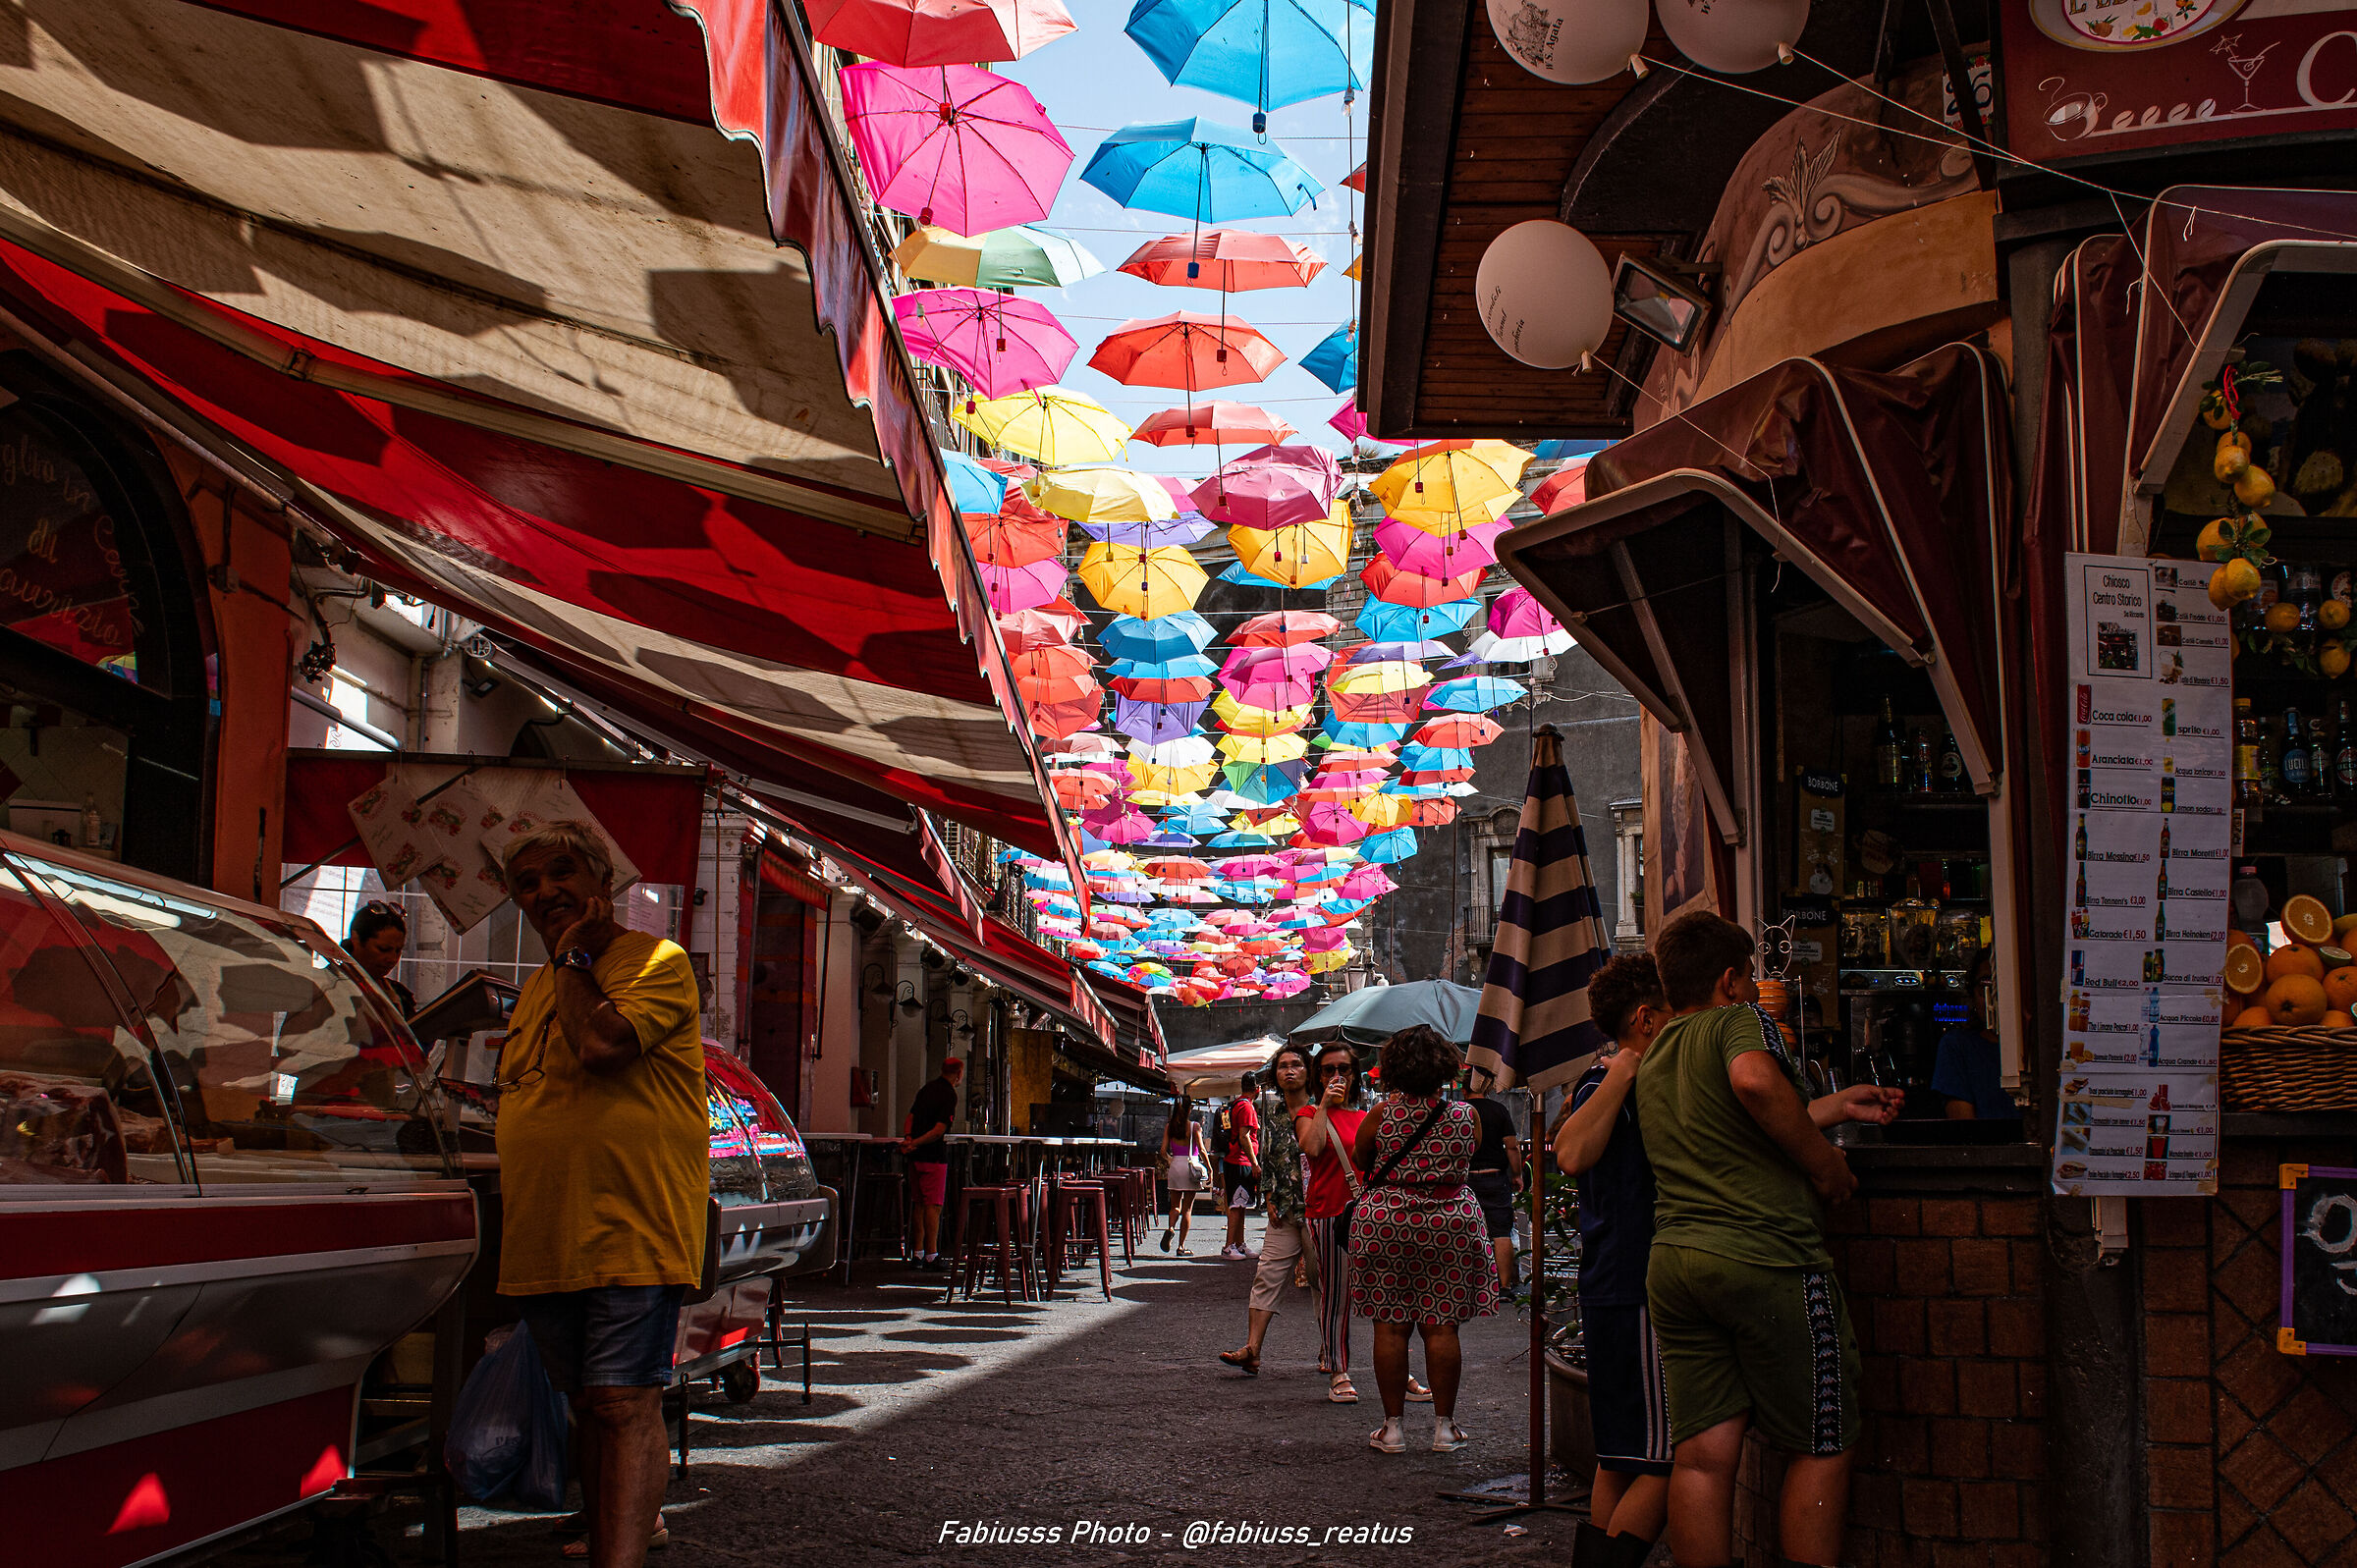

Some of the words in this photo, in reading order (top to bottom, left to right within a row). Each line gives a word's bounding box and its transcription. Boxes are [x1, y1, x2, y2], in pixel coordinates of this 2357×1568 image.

[1546, 18, 1563, 48] Agata
[2103, 574, 2130, 588] Chiosco
[2093, 591, 2116, 605] Centro
[2117, 593, 2142, 607] Storico
[2211, 676, 2228, 685] €1,50
[2092, 710, 2114, 721] Coca
[2115, 712, 2134, 722] cola
[2092, 754, 2134, 765] Aranciata
[1807, 776, 1838, 791] BORBONE
[2091, 792, 2137, 805] Chinotto
[2171, 848, 2189, 857] Birra
[2167, 888, 2183, 896] Birra
[2130, 895, 2146, 905] €3,00
[1782, 908, 1827, 922] BORBONE
[2123, 930, 2146, 941] €1,50
[2210, 932, 2226, 941] €2,00
[2085, 978, 2100, 987] Red
[2102, 978, 2117, 987] Bull
[2125, 1147, 2143, 1156] €1,50
